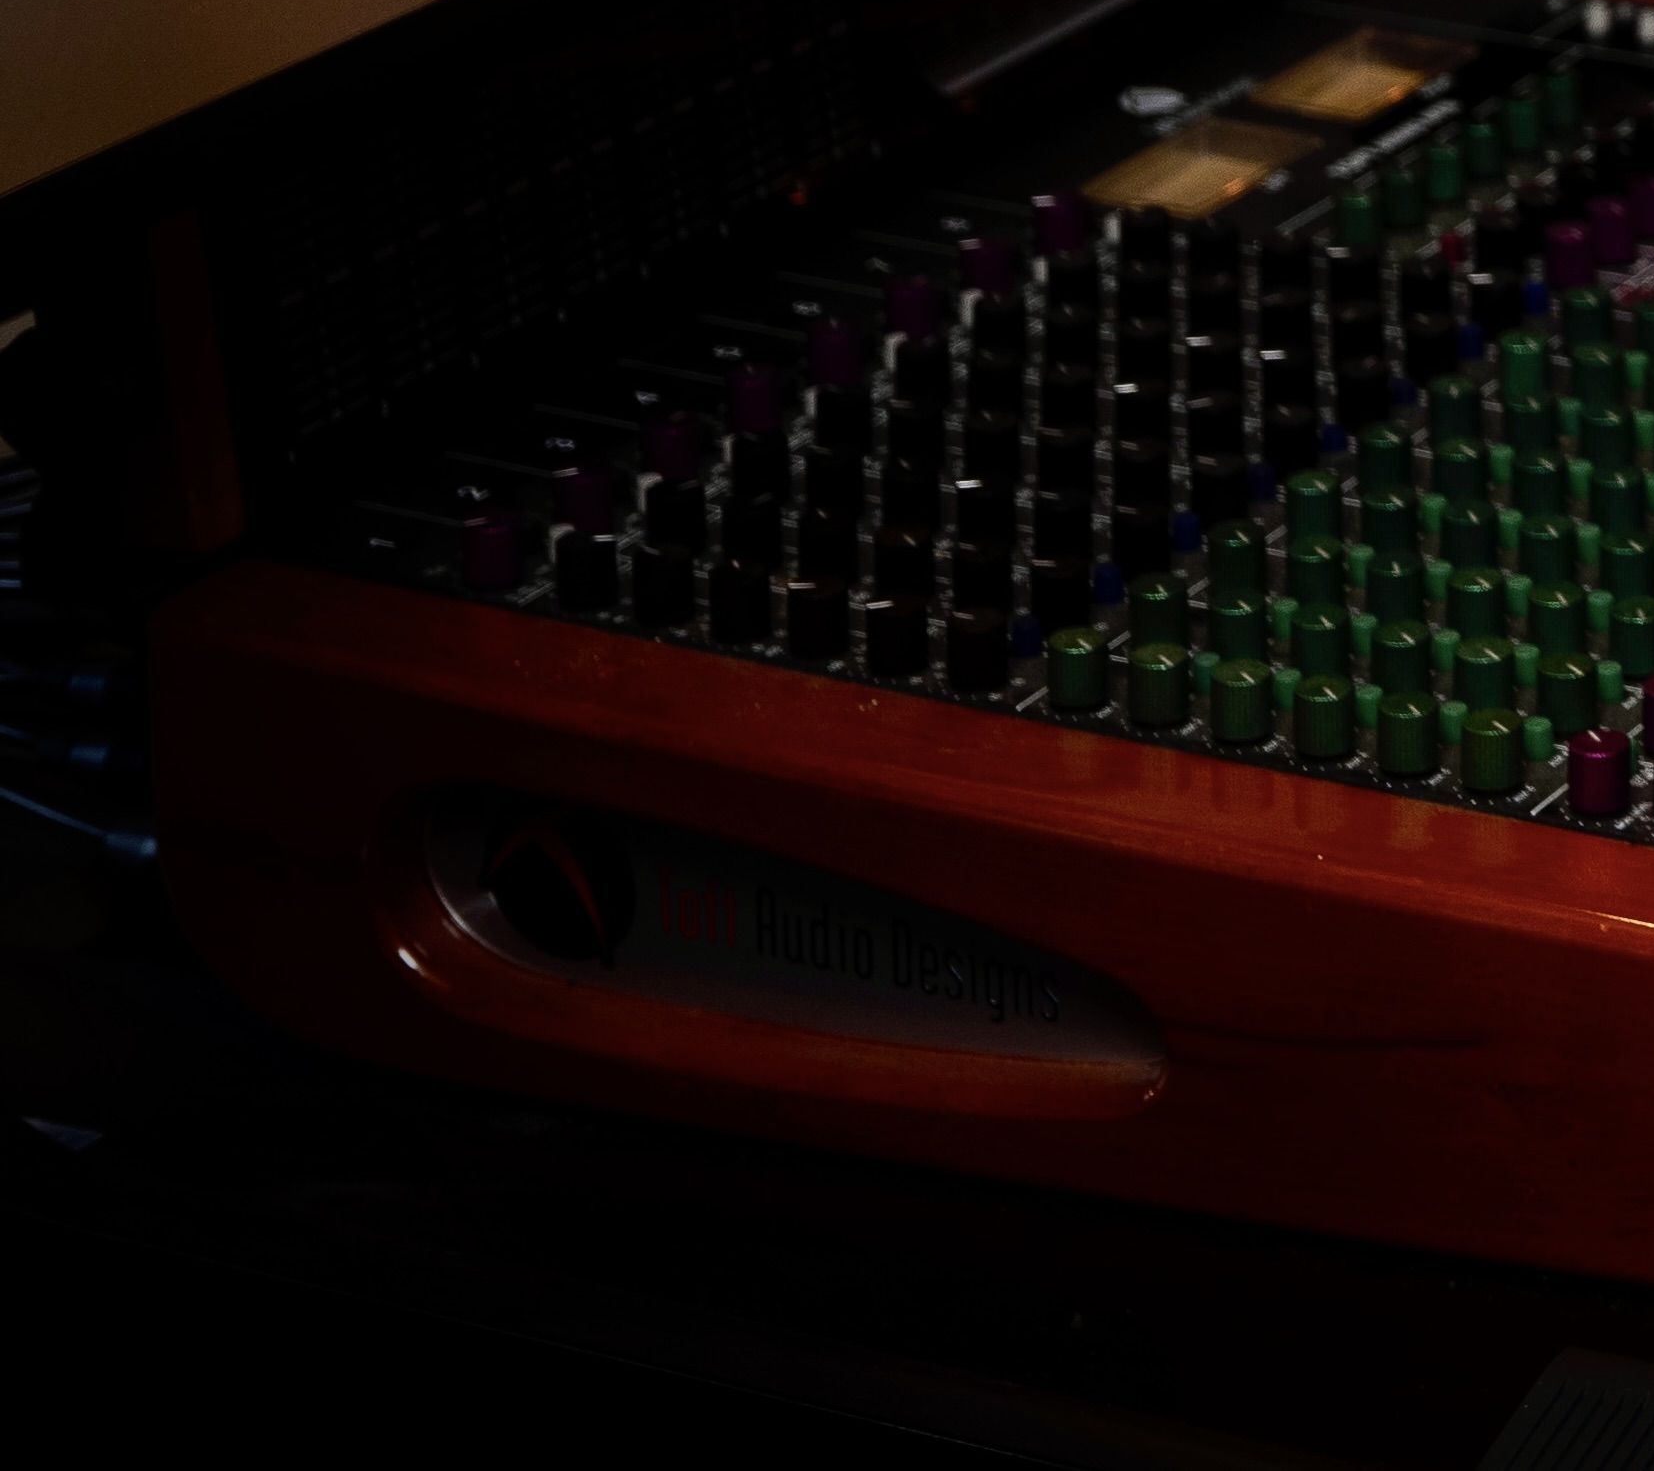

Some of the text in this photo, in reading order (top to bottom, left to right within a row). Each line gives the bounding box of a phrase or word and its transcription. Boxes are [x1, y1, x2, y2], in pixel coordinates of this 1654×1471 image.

[658, 862, 1061, 1023] Toft Audio Designs
